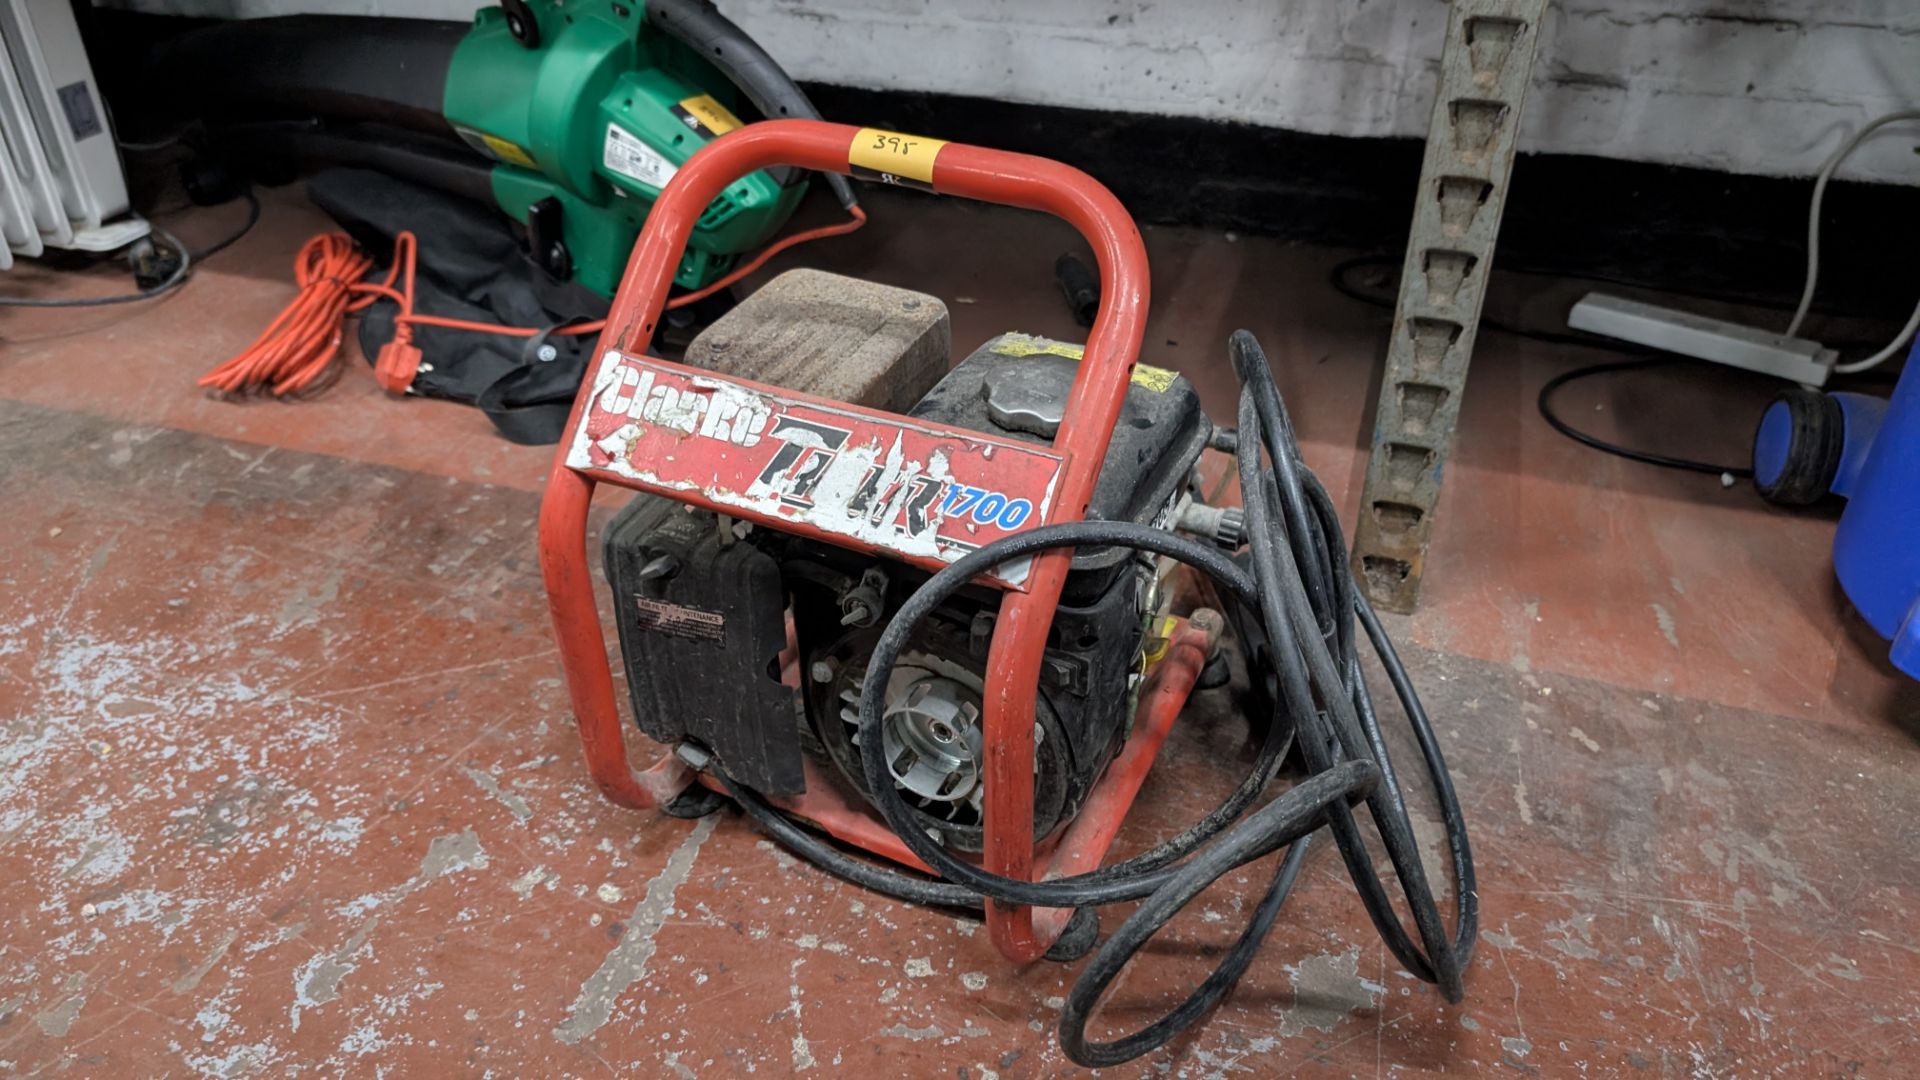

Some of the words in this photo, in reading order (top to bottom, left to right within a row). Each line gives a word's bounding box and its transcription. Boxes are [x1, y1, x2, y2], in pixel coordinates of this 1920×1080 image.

[872, 134, 919, 156] 395
[600, 364, 770, 448] Clarke
[940, 481, 1033, 531] 1700
